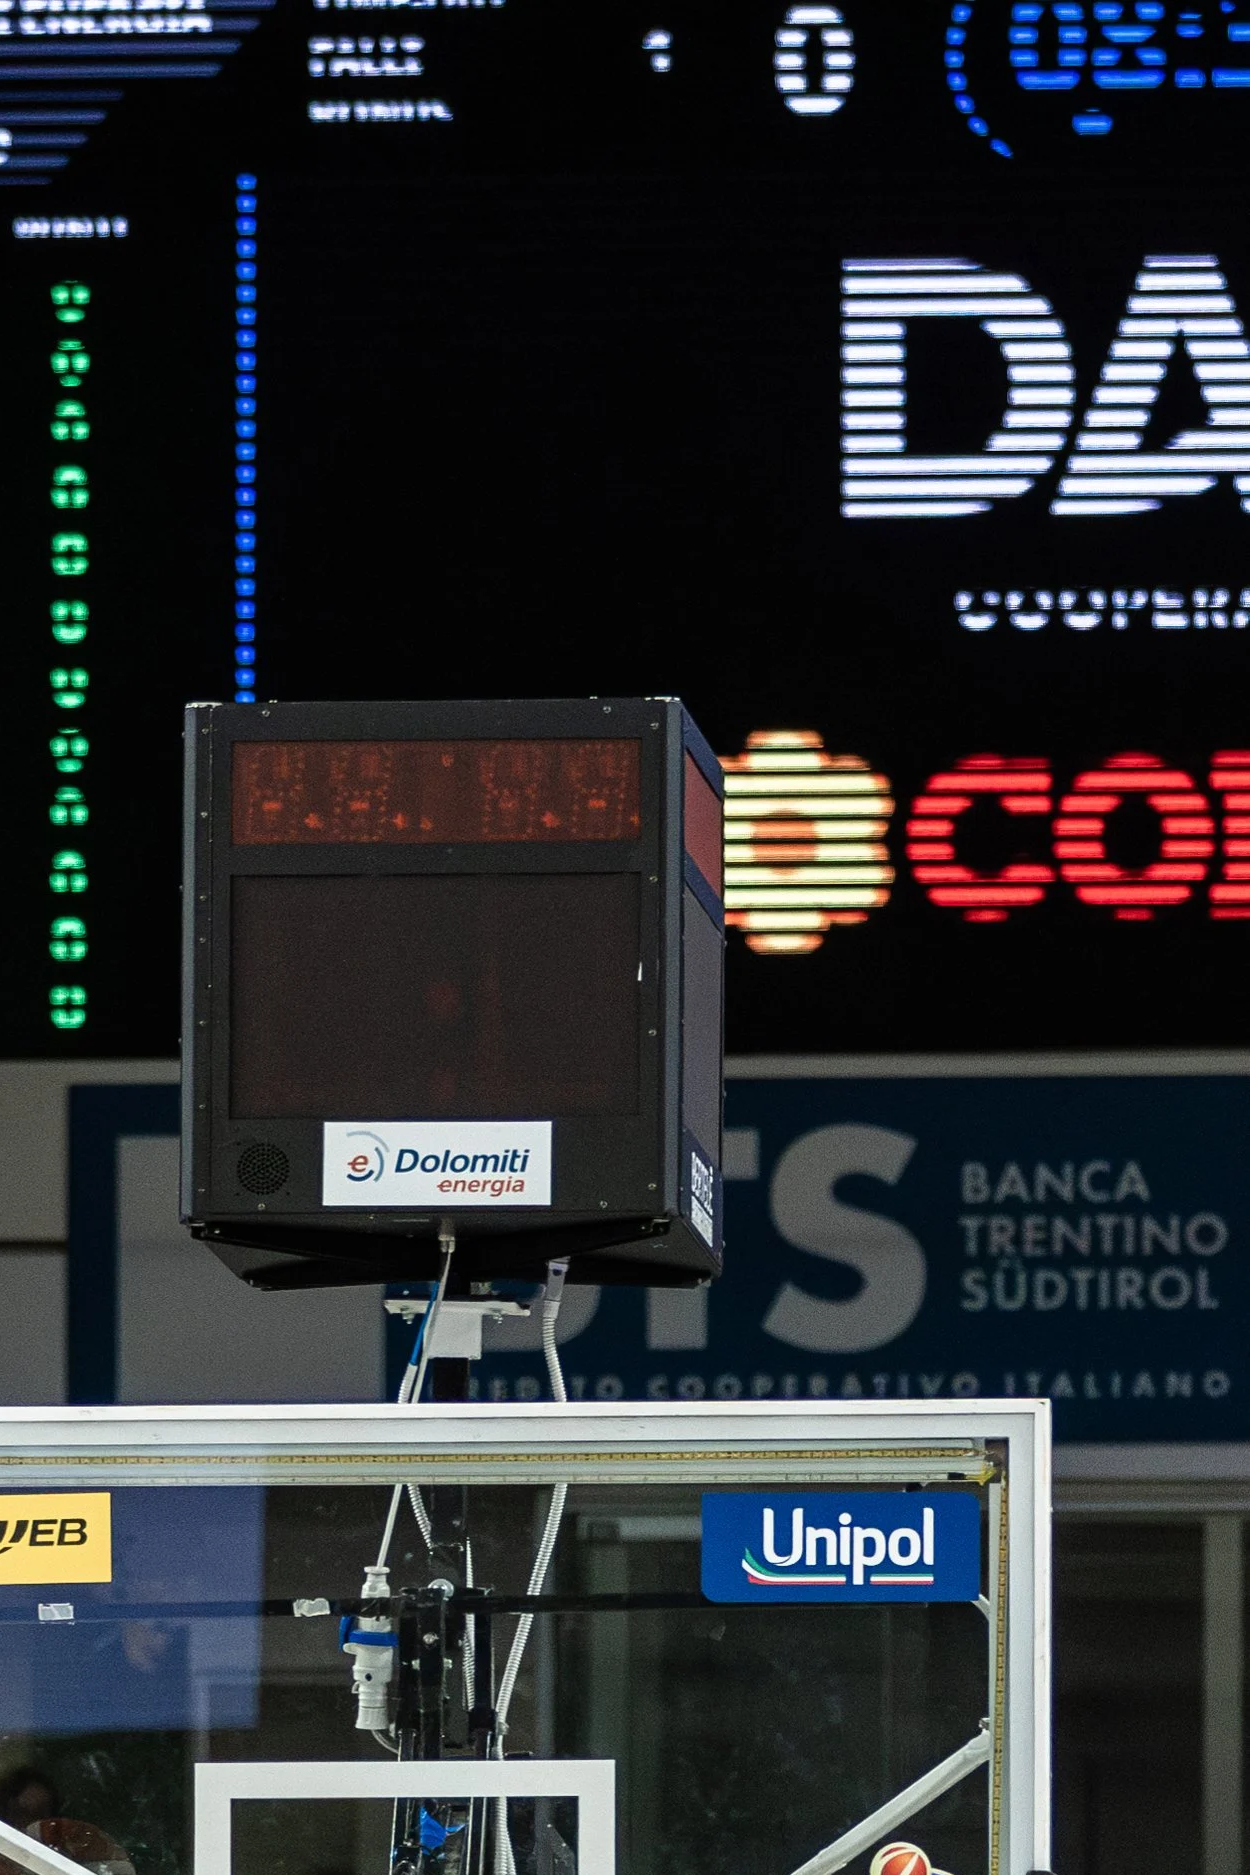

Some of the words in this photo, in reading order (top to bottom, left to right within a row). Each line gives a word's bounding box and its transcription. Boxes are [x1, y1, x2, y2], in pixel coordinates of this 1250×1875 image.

[394, 1148, 530, 1175] Dolomiti
[960, 1160, 1151, 1204] BANCA
[437, 1175, 525, 1198] energia
[959, 1212, 1229, 1257] TRENTINO
[960, 1256, 1221, 1313] SÜDTIROL
[645, 1372, 981, 1401] COOPERATIVO
[1004, 1370, 1234, 1400] ITALIANO
[761, 1507, 935, 1586] Unipol
